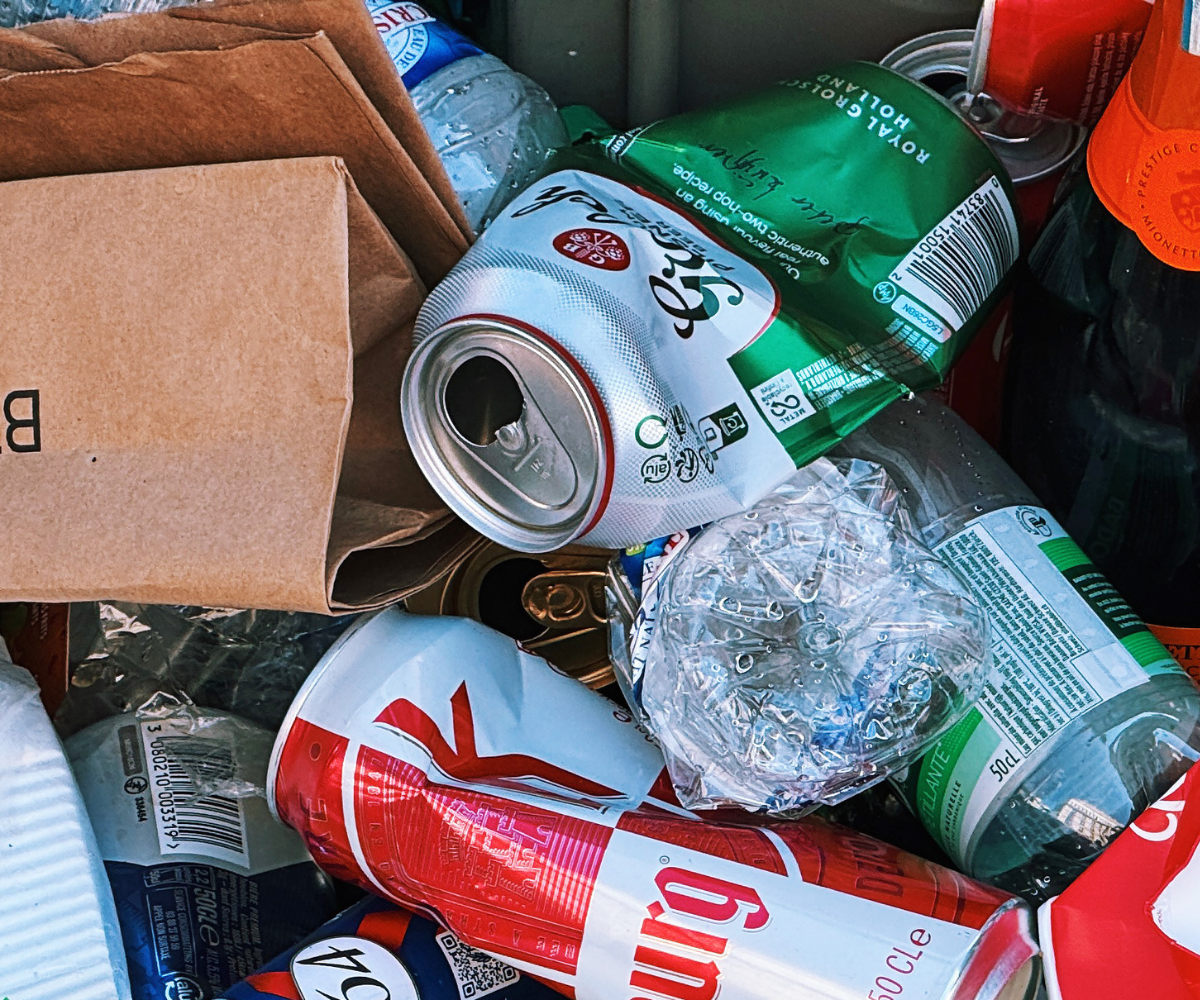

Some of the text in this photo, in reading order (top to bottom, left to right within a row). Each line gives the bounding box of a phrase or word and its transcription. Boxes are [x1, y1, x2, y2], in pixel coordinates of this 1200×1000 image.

[395, 28, 425, 69] EAU DE
[816, 72, 910, 130] HOLLAND
[864, 114, 931, 165] ROYAL
[674, 186, 695, 204] an
[1137, 143, 1180, 198] PRESTIGE
[671, 161, 828, 266] authentic two-hop recipe.
[948, 191, 983, 225] 83741
[911, 223, 950, 258] 15001
[148, 740, 168, 787] 080210
[158, 791, 179, 839] 003319
